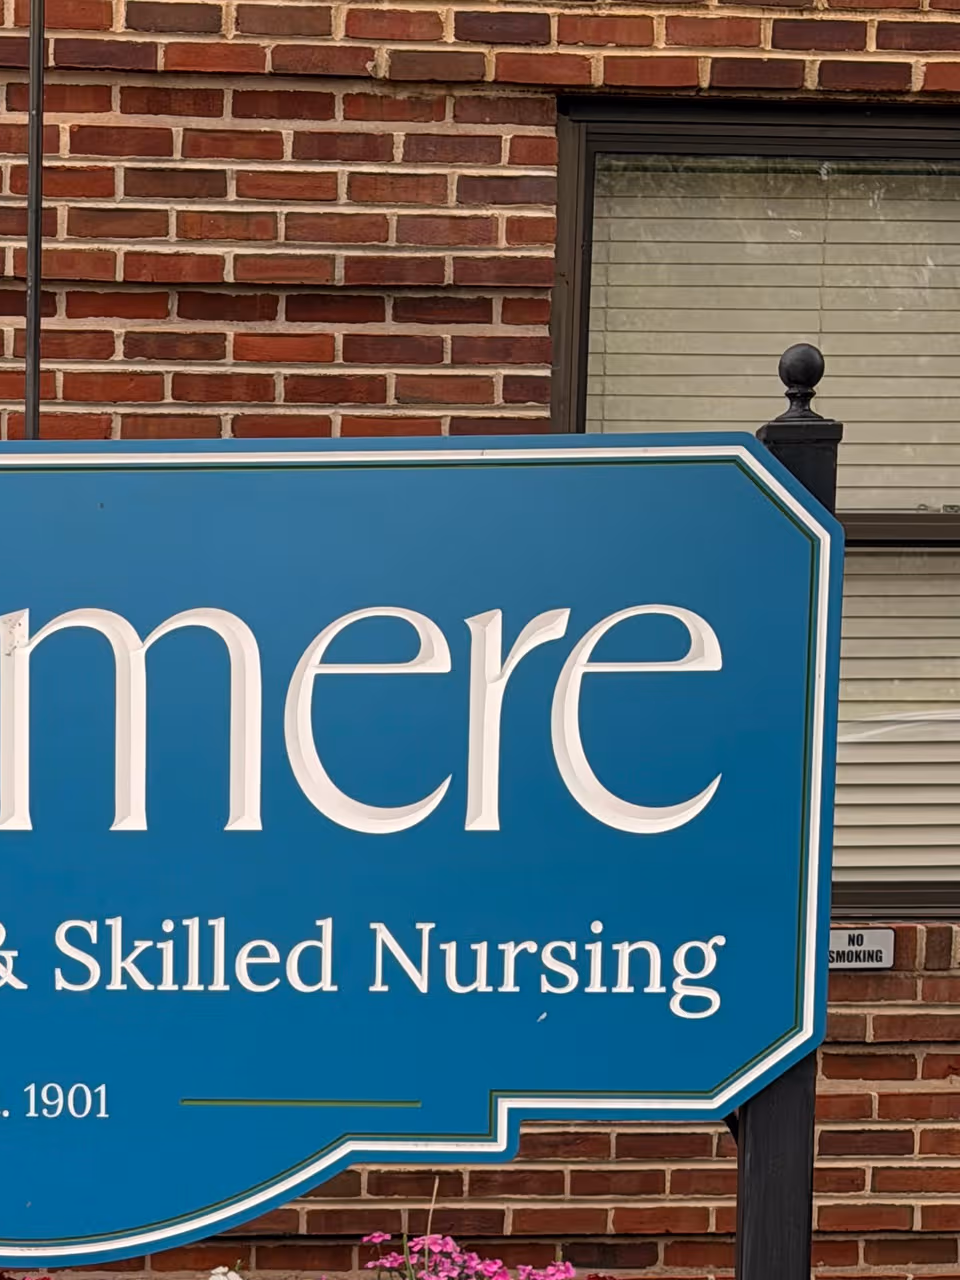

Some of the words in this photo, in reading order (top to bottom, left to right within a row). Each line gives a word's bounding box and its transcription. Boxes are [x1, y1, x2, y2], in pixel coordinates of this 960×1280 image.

[847, 933, 864, 947] NO
[54, 915, 338, 993] Skilled
[368, 921, 726, 1019] Nursing
[828, 949, 883, 963] SMOKING
[23, 1082, 110, 1118] 1901
